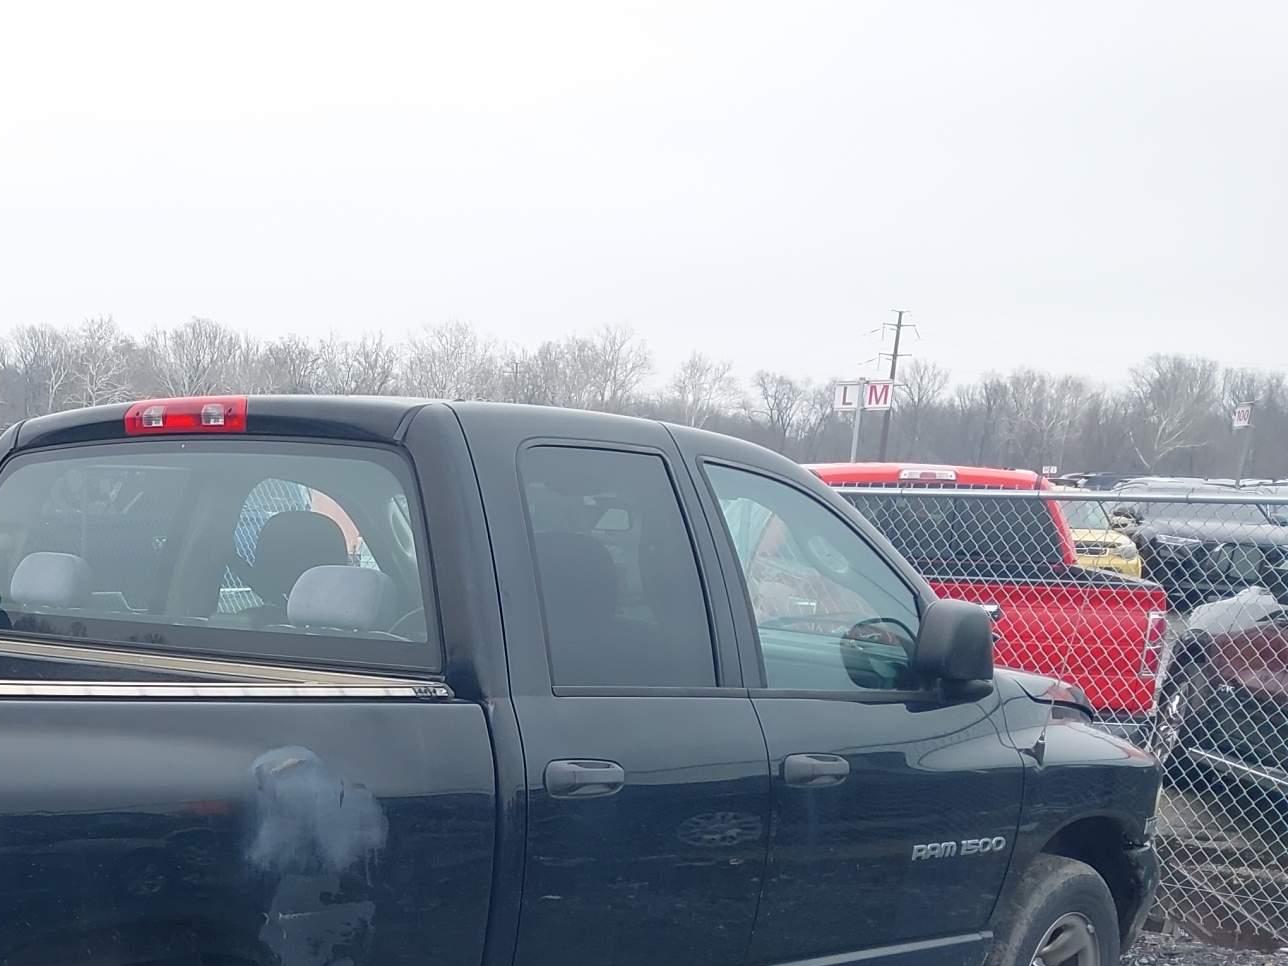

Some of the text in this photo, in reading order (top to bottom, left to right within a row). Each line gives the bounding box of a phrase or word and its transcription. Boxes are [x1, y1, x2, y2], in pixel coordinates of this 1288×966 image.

[841, 386, 853, 406] L
[868, 384, 890, 406] M
[911, 836, 1007, 861] RAM 1500
